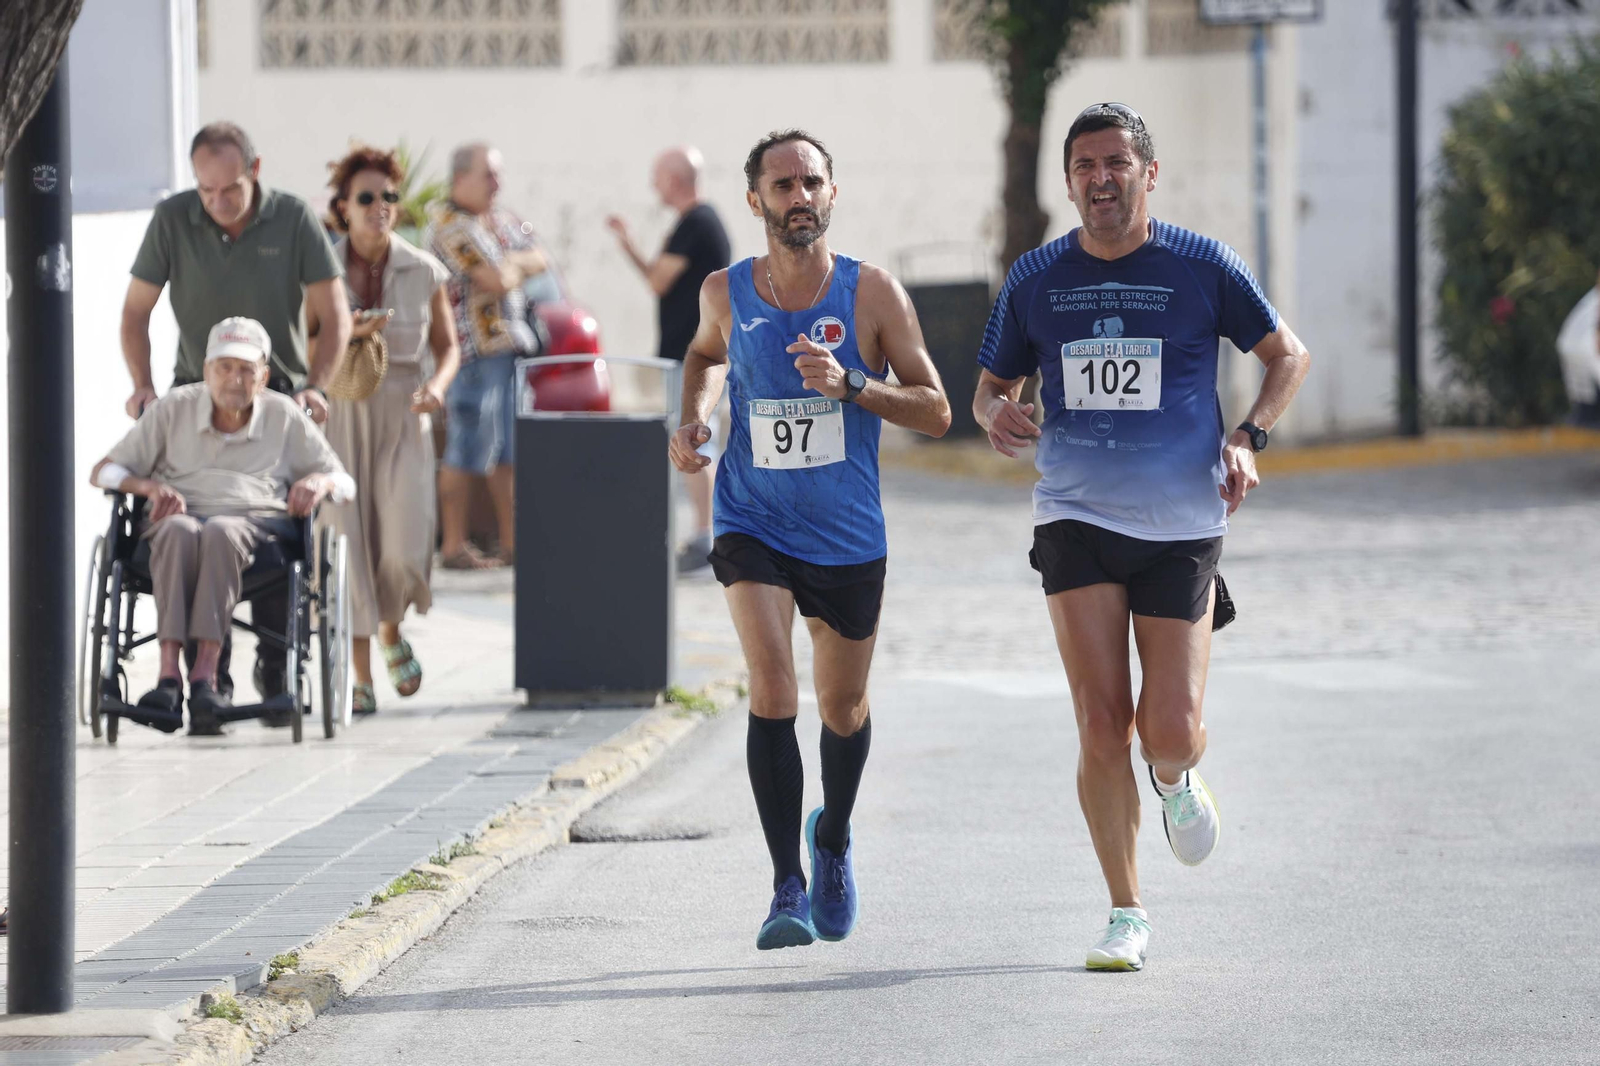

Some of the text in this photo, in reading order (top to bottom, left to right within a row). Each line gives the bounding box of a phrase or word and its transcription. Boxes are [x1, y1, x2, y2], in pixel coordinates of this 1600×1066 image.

[32, 164, 56, 174] TARIFA
[1050, 292, 1169, 303] IX CARRERA DEL ESTRECHO
[1052, 301, 1166, 312] MEMORIAL PEPE SERRANO
[1104, 342, 1123, 358] ELA
[1125, 344, 1152, 356] TARIFA
[1081, 359, 1141, 395] 102
[784, 402, 805, 418] ELA
[806, 401, 832, 414] TARIFA
[773, 418, 814, 454] 97
